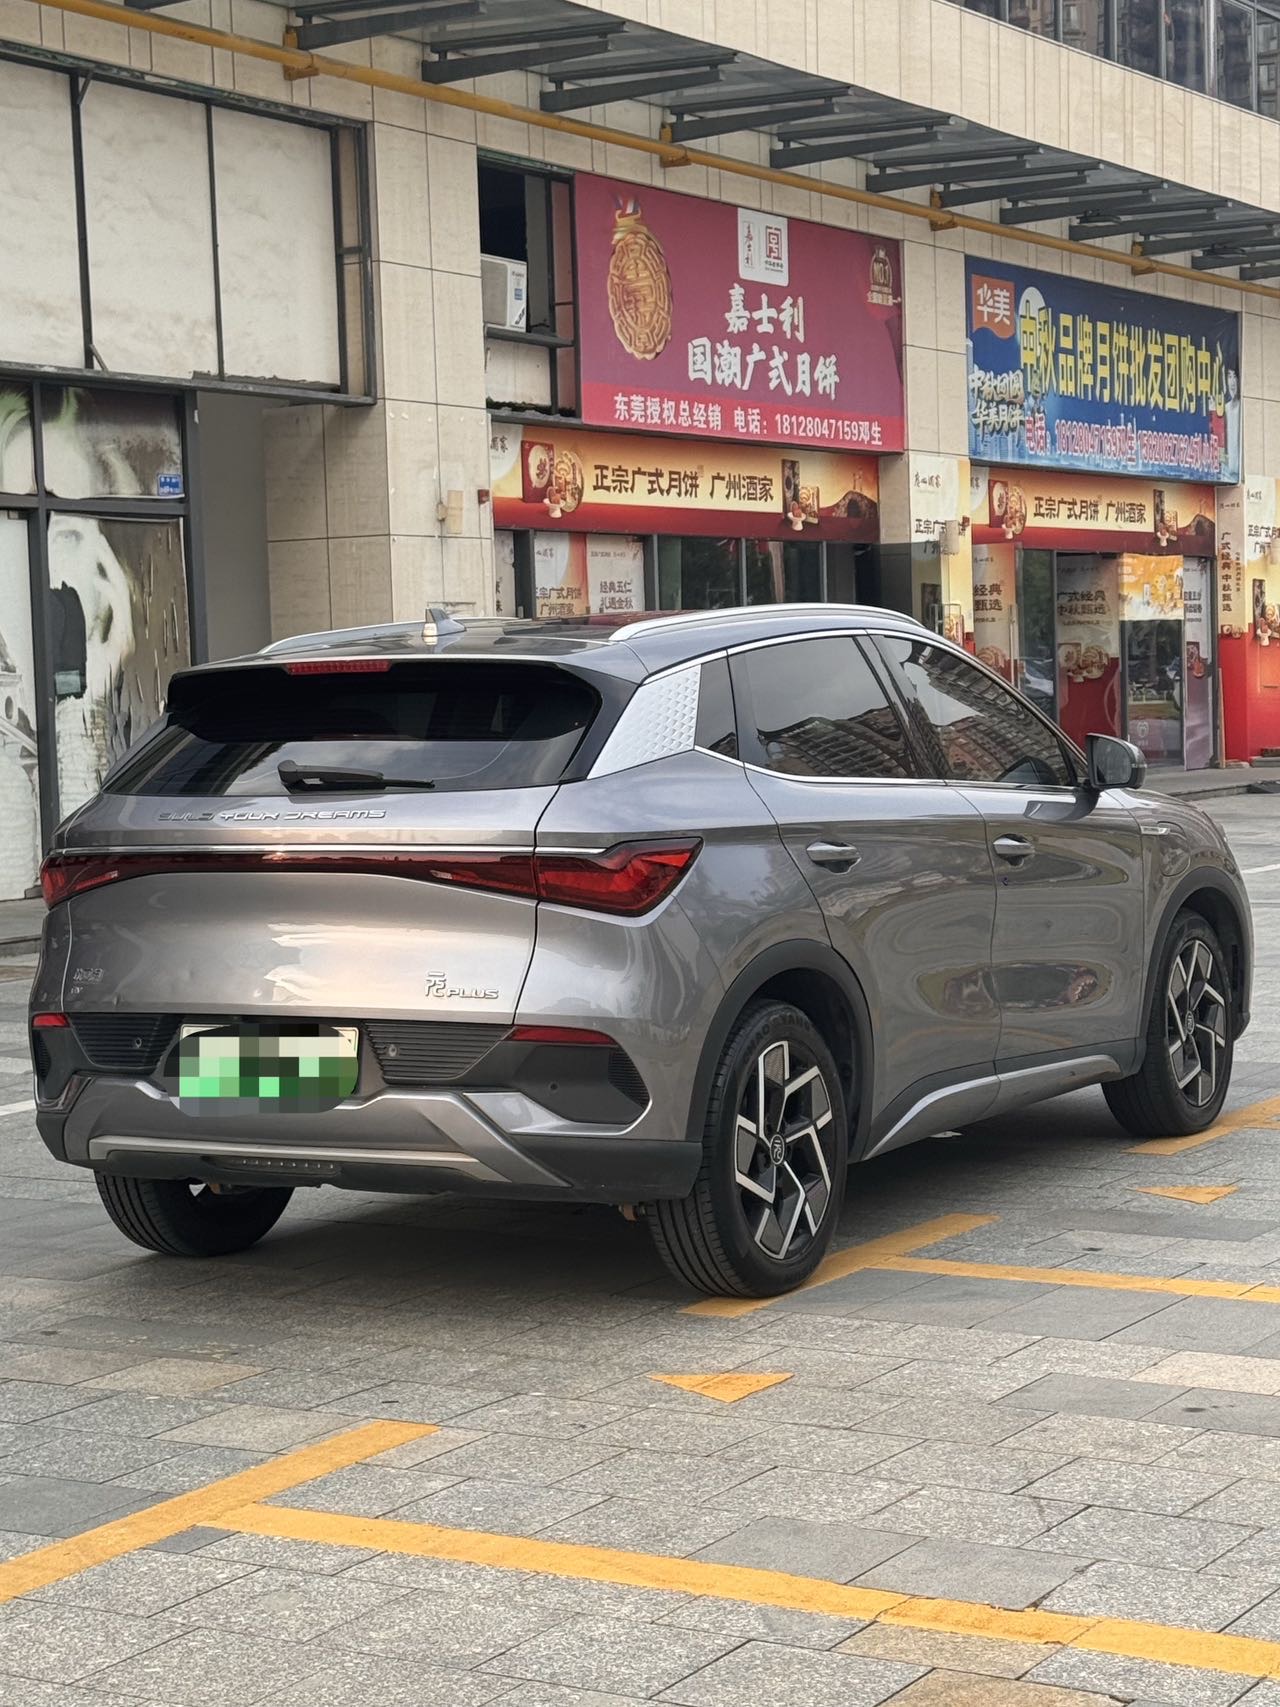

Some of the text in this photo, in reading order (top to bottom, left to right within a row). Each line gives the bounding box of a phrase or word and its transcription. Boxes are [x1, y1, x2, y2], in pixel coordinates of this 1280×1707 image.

[724, 283, 805, 343] 嘉士利
[977, 283, 1011, 326] 华美
[687, 336, 840, 401] 国潮广式月饼
[1020, 299, 1227, 417] 中秋品牌月饼批发团购中心
[613, 392, 723, 432] 东莞授权总经销
[970, 400, 1025, 440] 华美月饼
[592, 463, 774, 503] 正宗广式月饼 广州酒家
[1033, 496, 1147, 524] 正宗广式月饼 广州酒家
[600, 580, 633, 594] 经典五仁
[600, 596, 634, 610] 礼遇金秋
[1056, 591, 1106, 602] 广式经典
[540, 603, 575, 616] 广州酒家
[219, 810, 281, 822] YOUR
[283, 809, 387, 821] DREAMS
